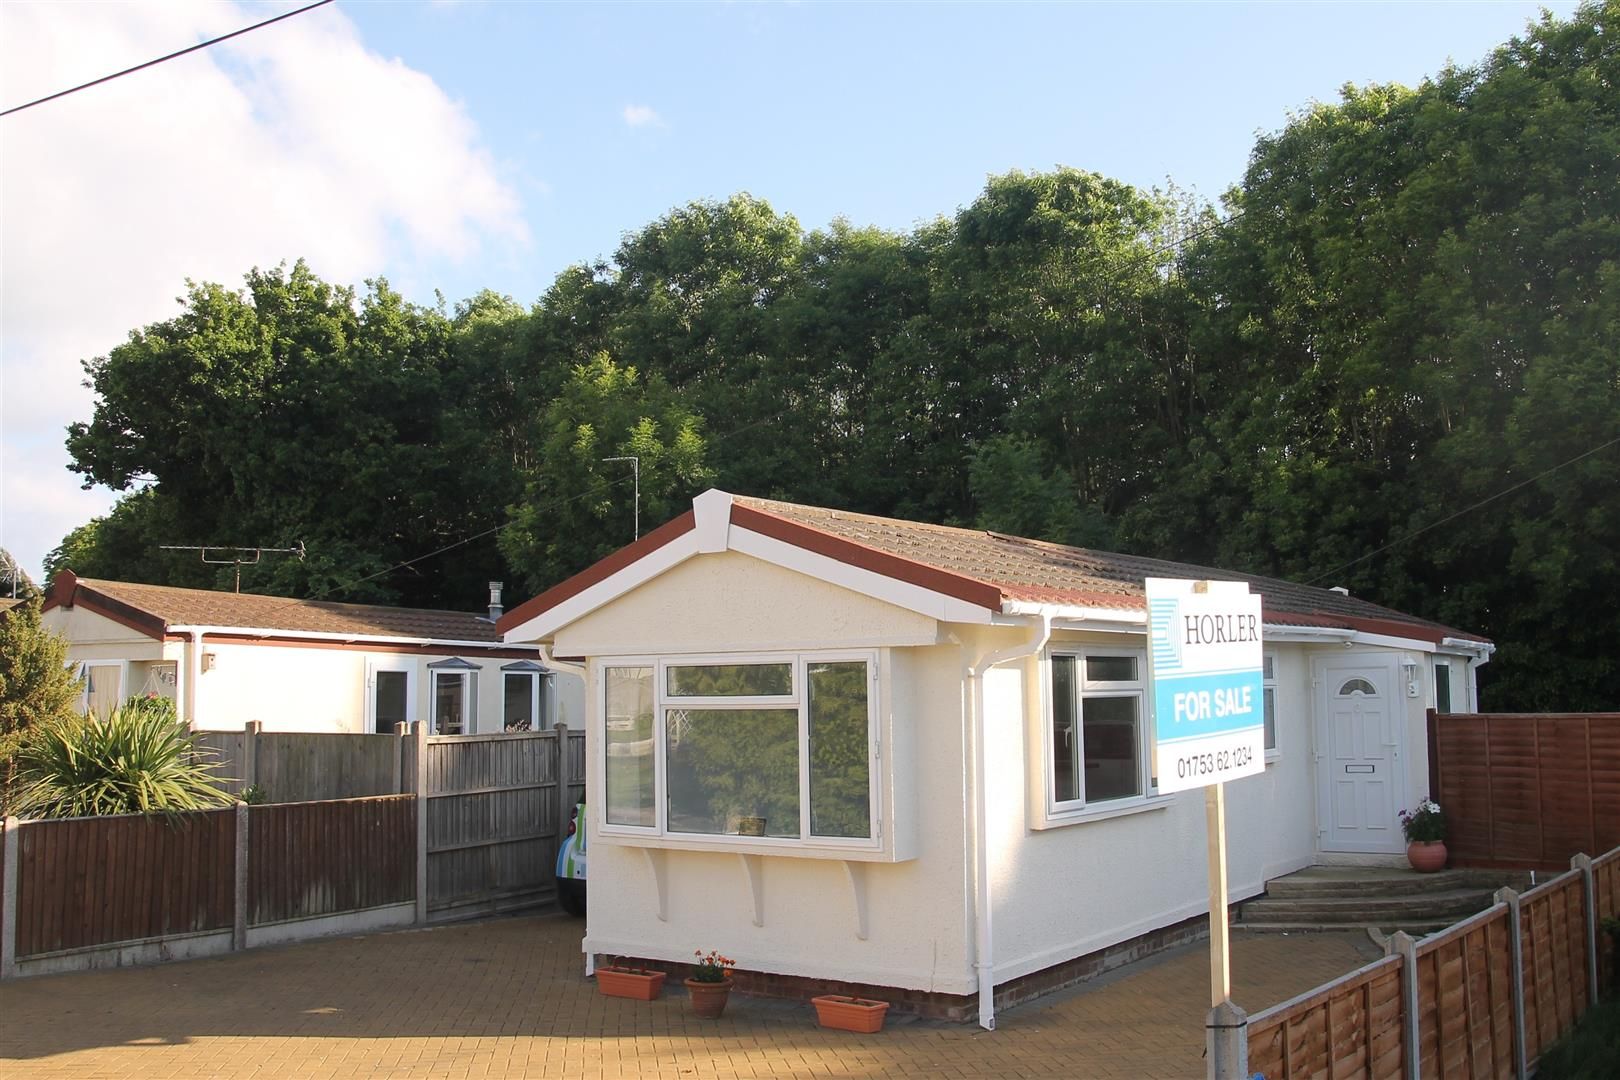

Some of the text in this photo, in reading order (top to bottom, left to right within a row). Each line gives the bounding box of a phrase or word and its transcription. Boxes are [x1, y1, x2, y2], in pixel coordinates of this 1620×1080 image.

[1185, 614, 1258, 644] HORLER
[1174, 686, 1251, 722] FOR SALE
[1177, 753, 1213, 778] 01753
